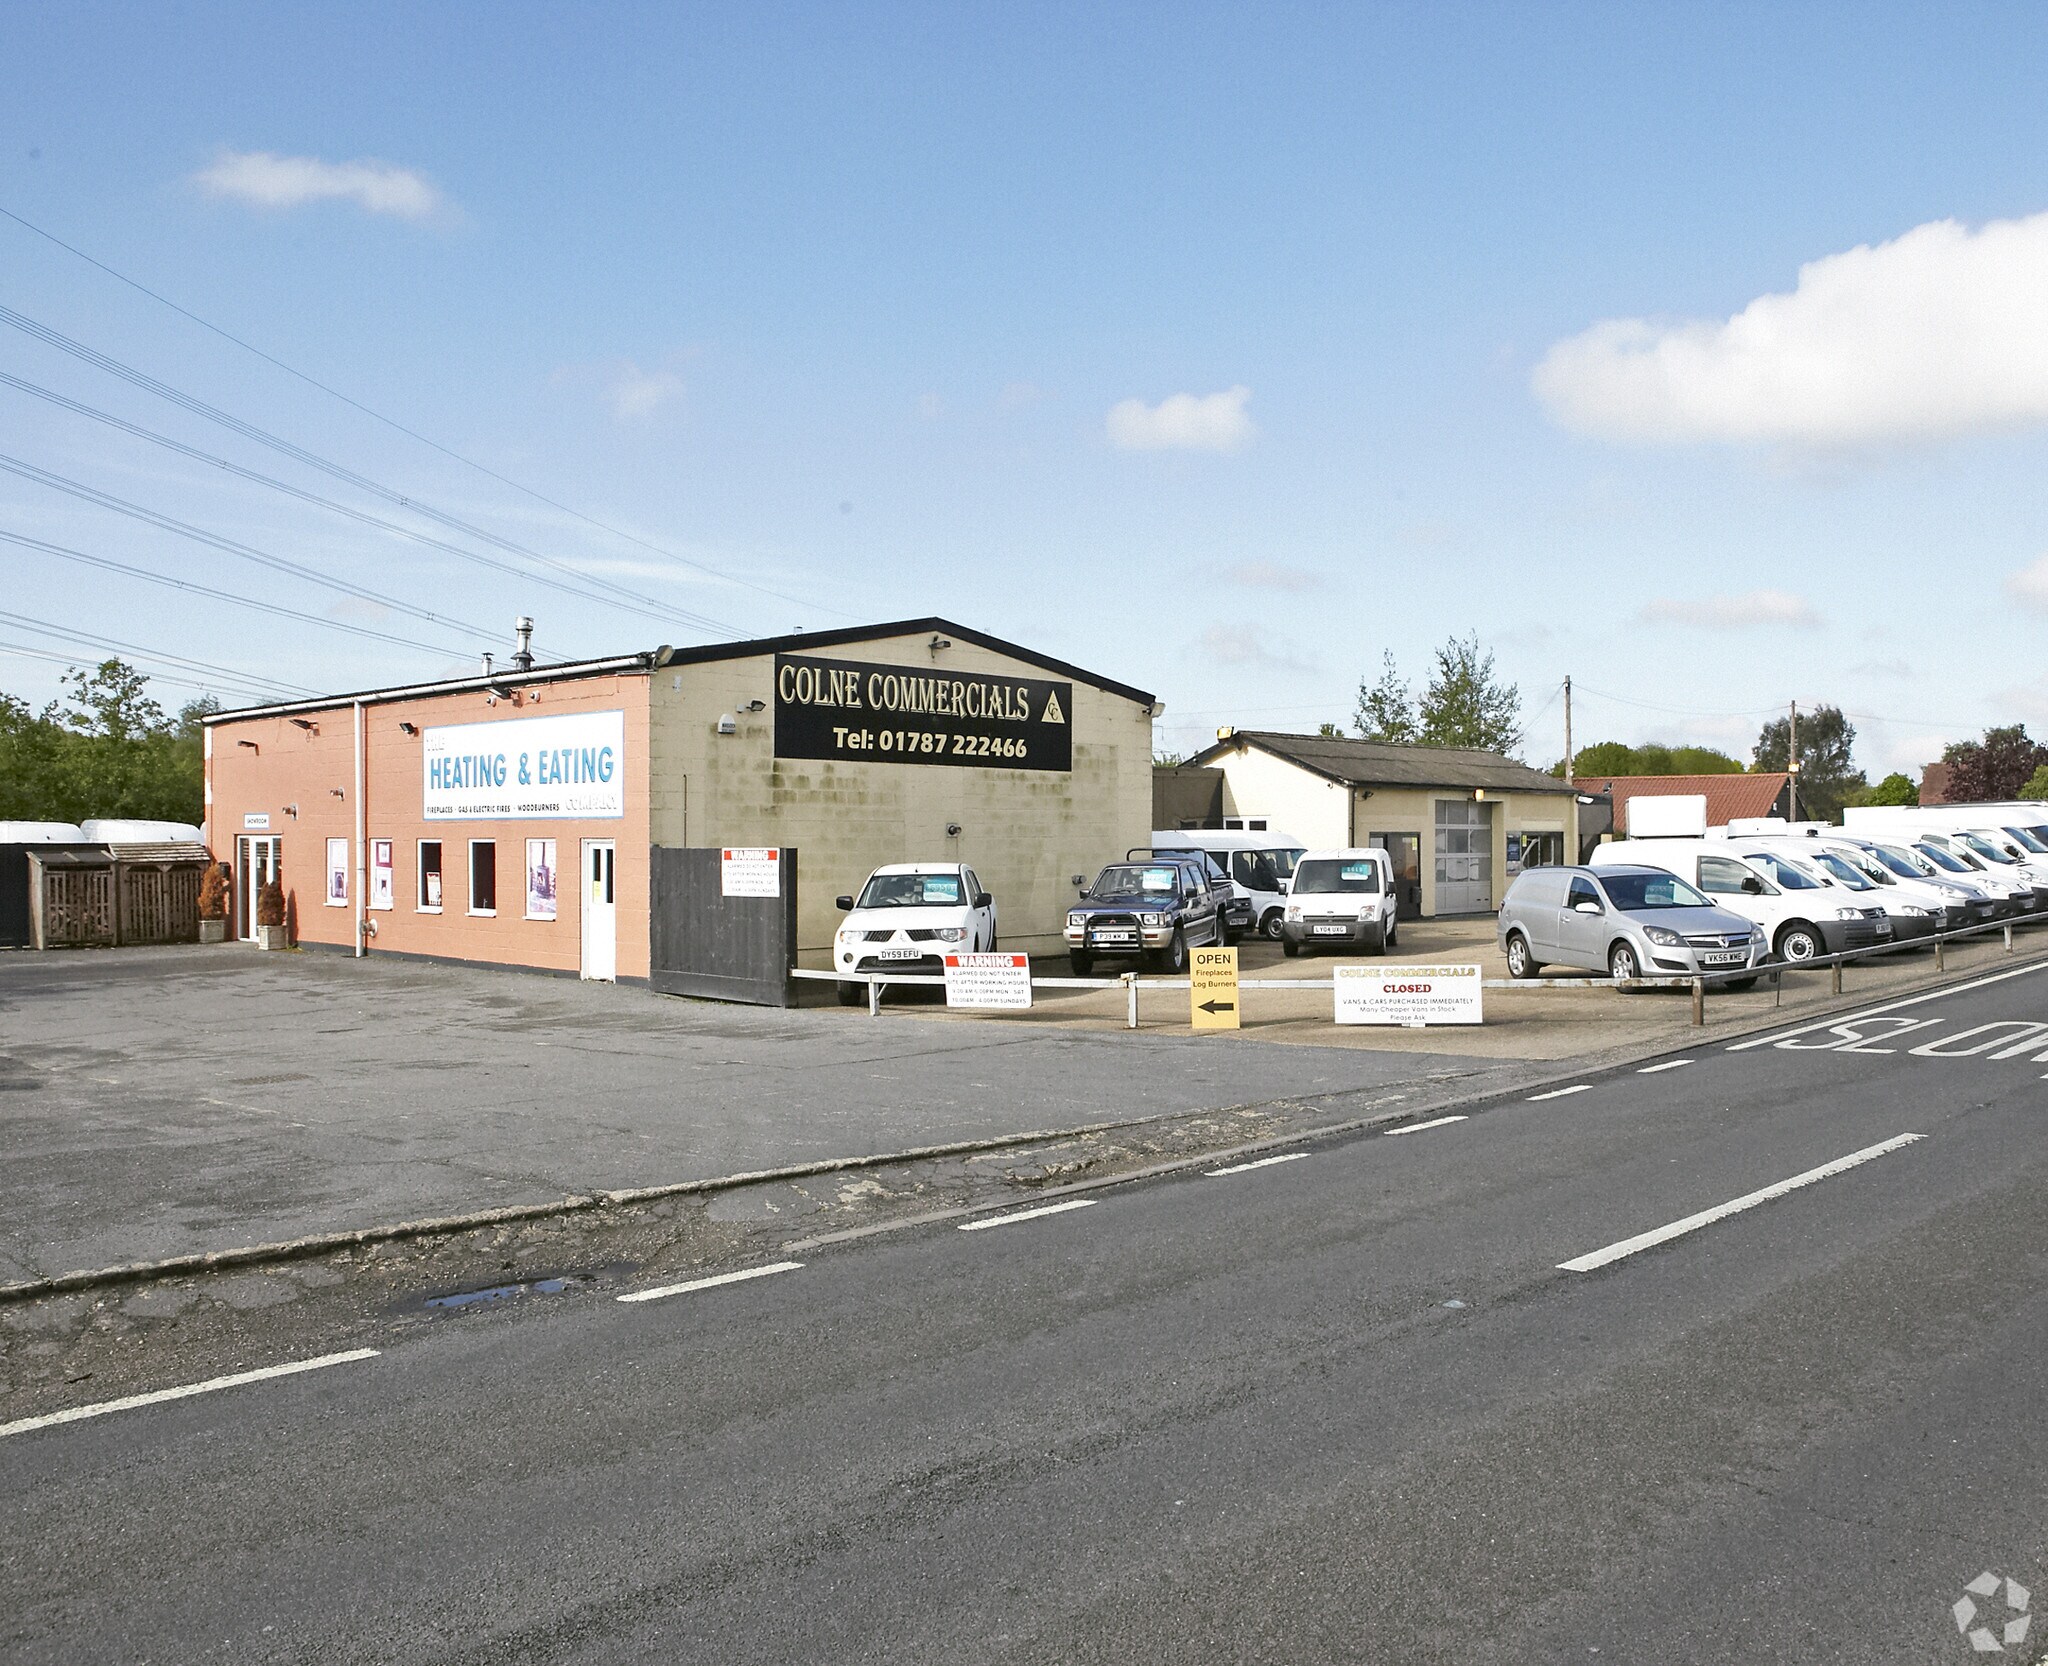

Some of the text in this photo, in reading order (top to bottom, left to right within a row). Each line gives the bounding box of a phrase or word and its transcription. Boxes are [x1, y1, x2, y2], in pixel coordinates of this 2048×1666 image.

[779, 664, 1030, 722] COLNE COMMERCIALS
[833, 727, 1028, 758] Tel: 01787 222466
[430, 746, 614, 790] HEATING & EATING
[427, 806, 453, 814] FIREPLACES
[473, 805, 496, 813] ELECTRIC
[496, 804, 511, 813] FIRES
[881, 950, 919, 959] DY59 EFU
[1197, 954, 1231, 965] OPEN
[1708, 953, 1728, 962] VK56
[957, 955, 1014, 968] WARNING
[1196, 969, 1232, 978] Fireplaces
[1340, 967, 1476, 978] COLNE COMMERCIALS
[1193, 980, 1237, 989] Log Burners
[1383, 984, 1432, 993] CLOSED
